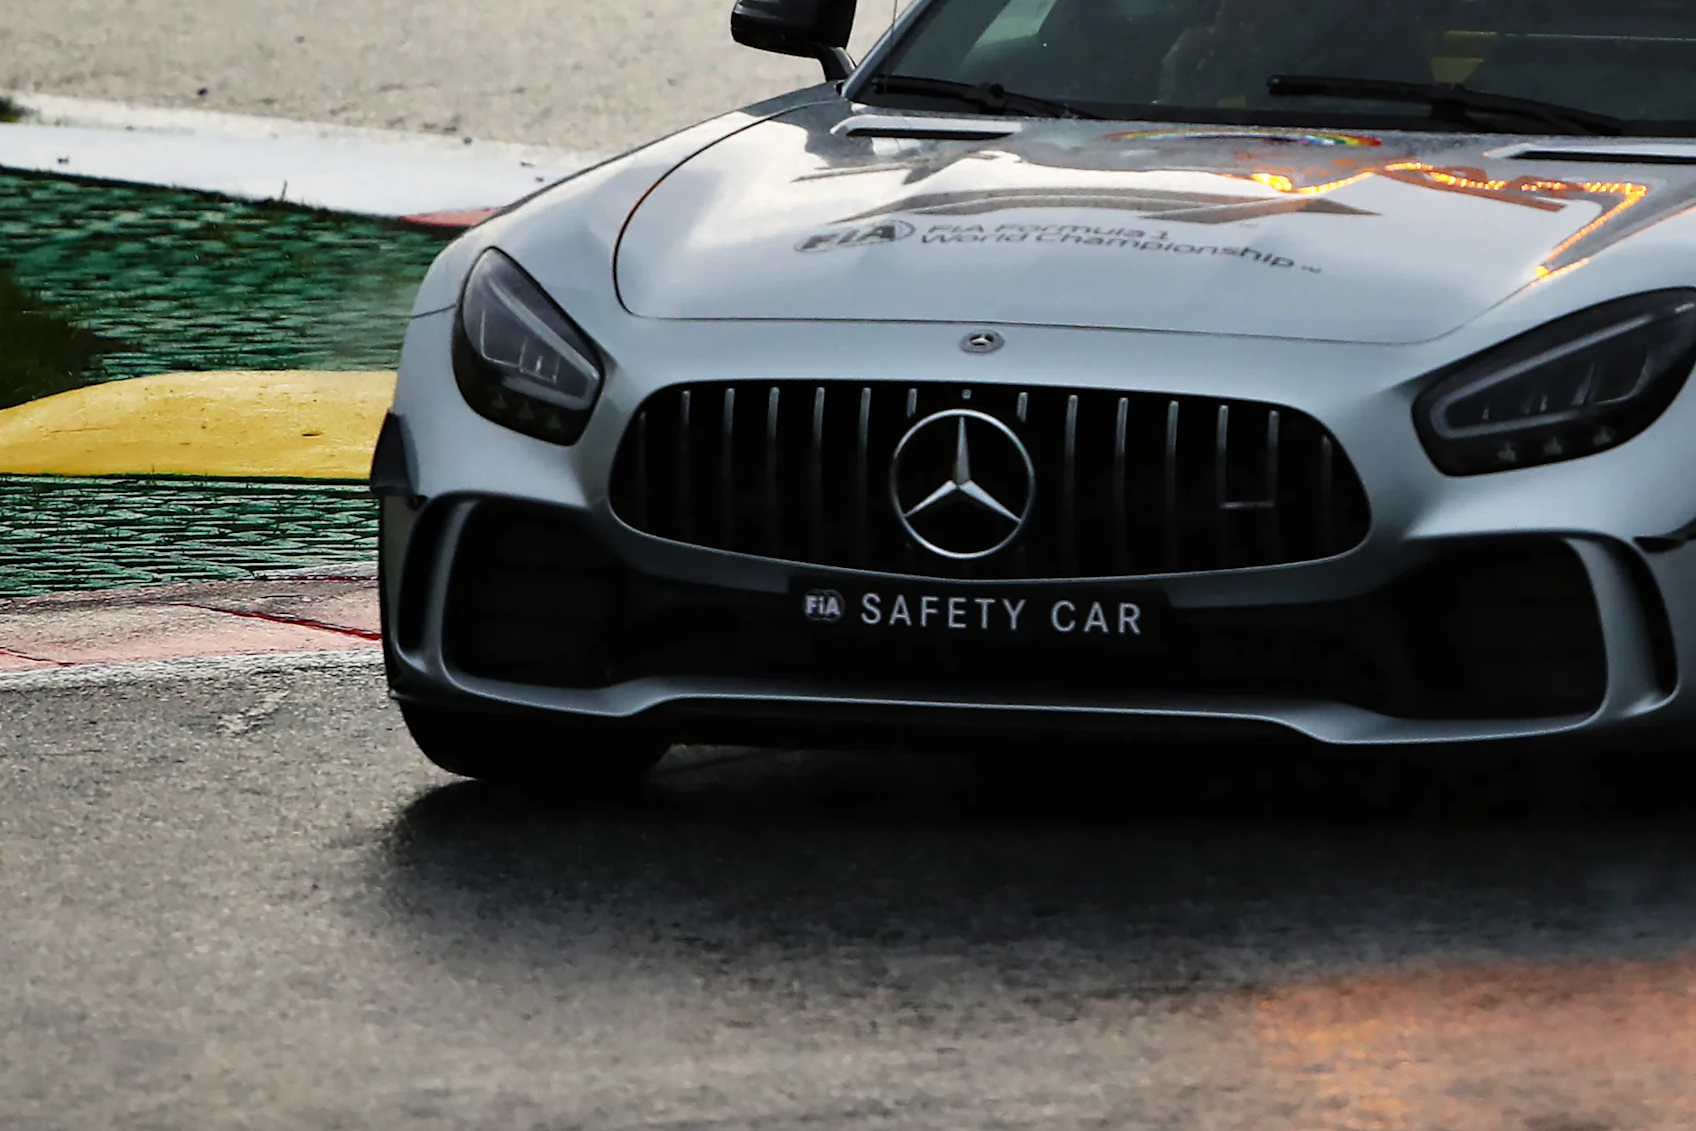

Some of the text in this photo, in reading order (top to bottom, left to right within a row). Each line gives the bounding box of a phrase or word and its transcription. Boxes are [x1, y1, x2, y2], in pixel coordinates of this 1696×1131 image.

[994, 223, 1146, 238] Formula
[922, 231, 1296, 269] World Championship
[860, 592, 1028, 632] SAFETY
[1050, 599, 1142, 636] CAR
